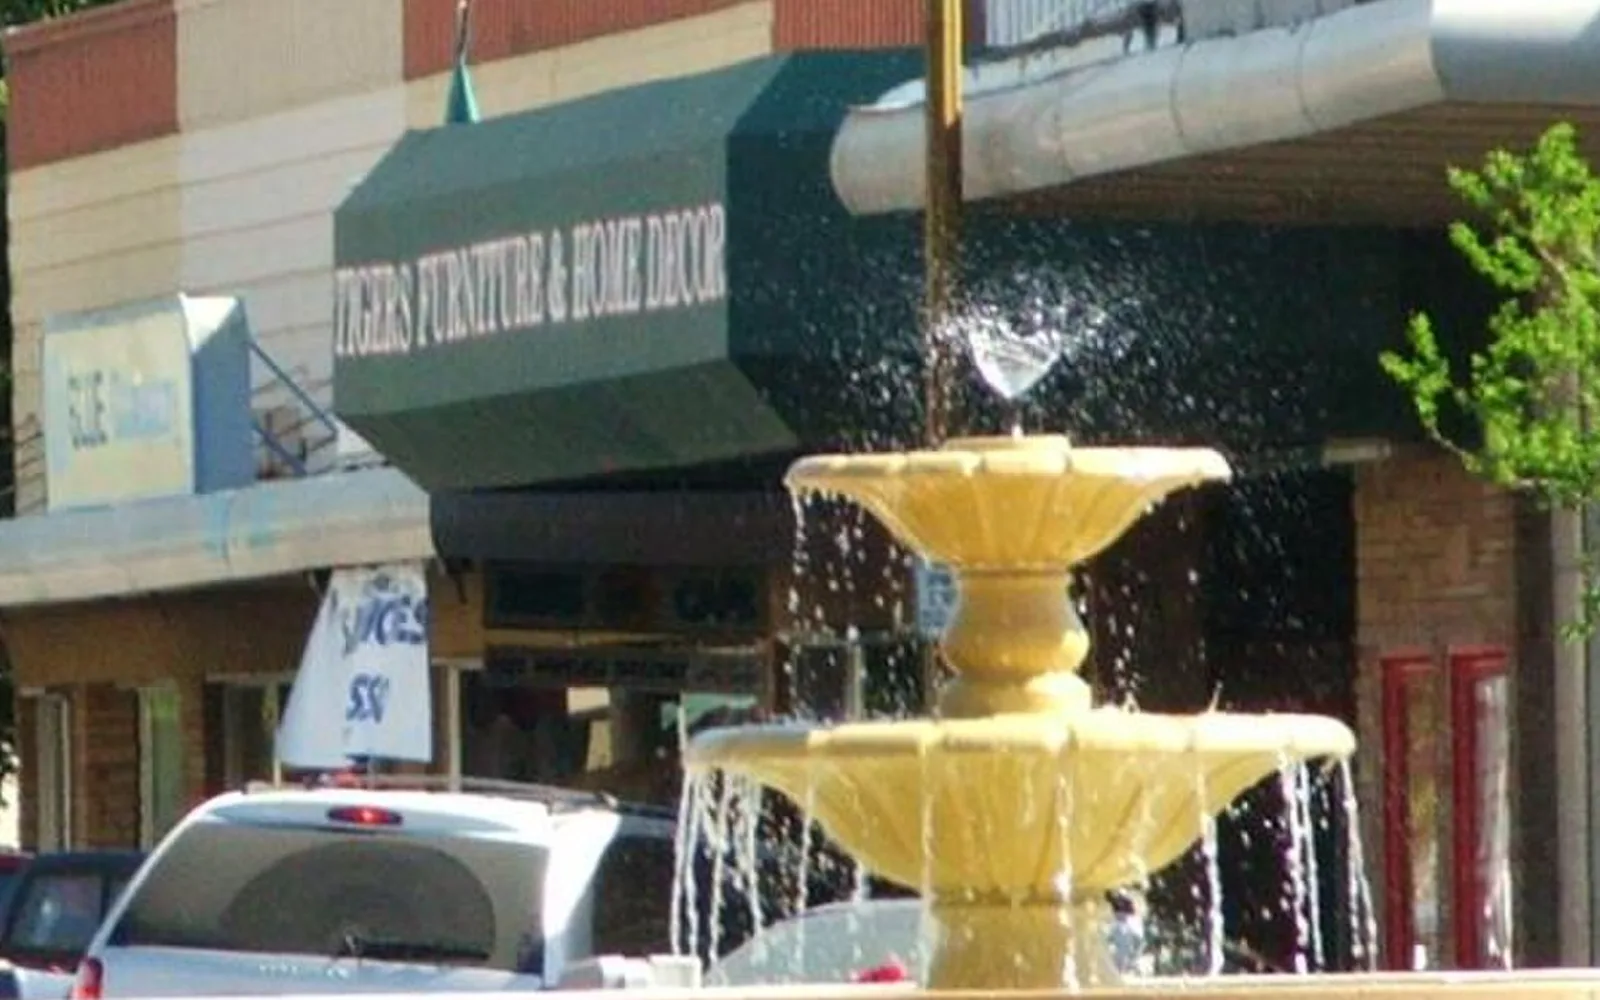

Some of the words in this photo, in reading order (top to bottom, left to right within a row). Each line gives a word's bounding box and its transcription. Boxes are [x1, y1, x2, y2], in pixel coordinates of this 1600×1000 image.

[334, 264, 411, 355] TIGERS
[417, 231, 544, 346] FURNITURE
[548, 227, 567, 323] &
[572, 217, 641, 321] HOME
[646, 203, 726, 308] DECOR
